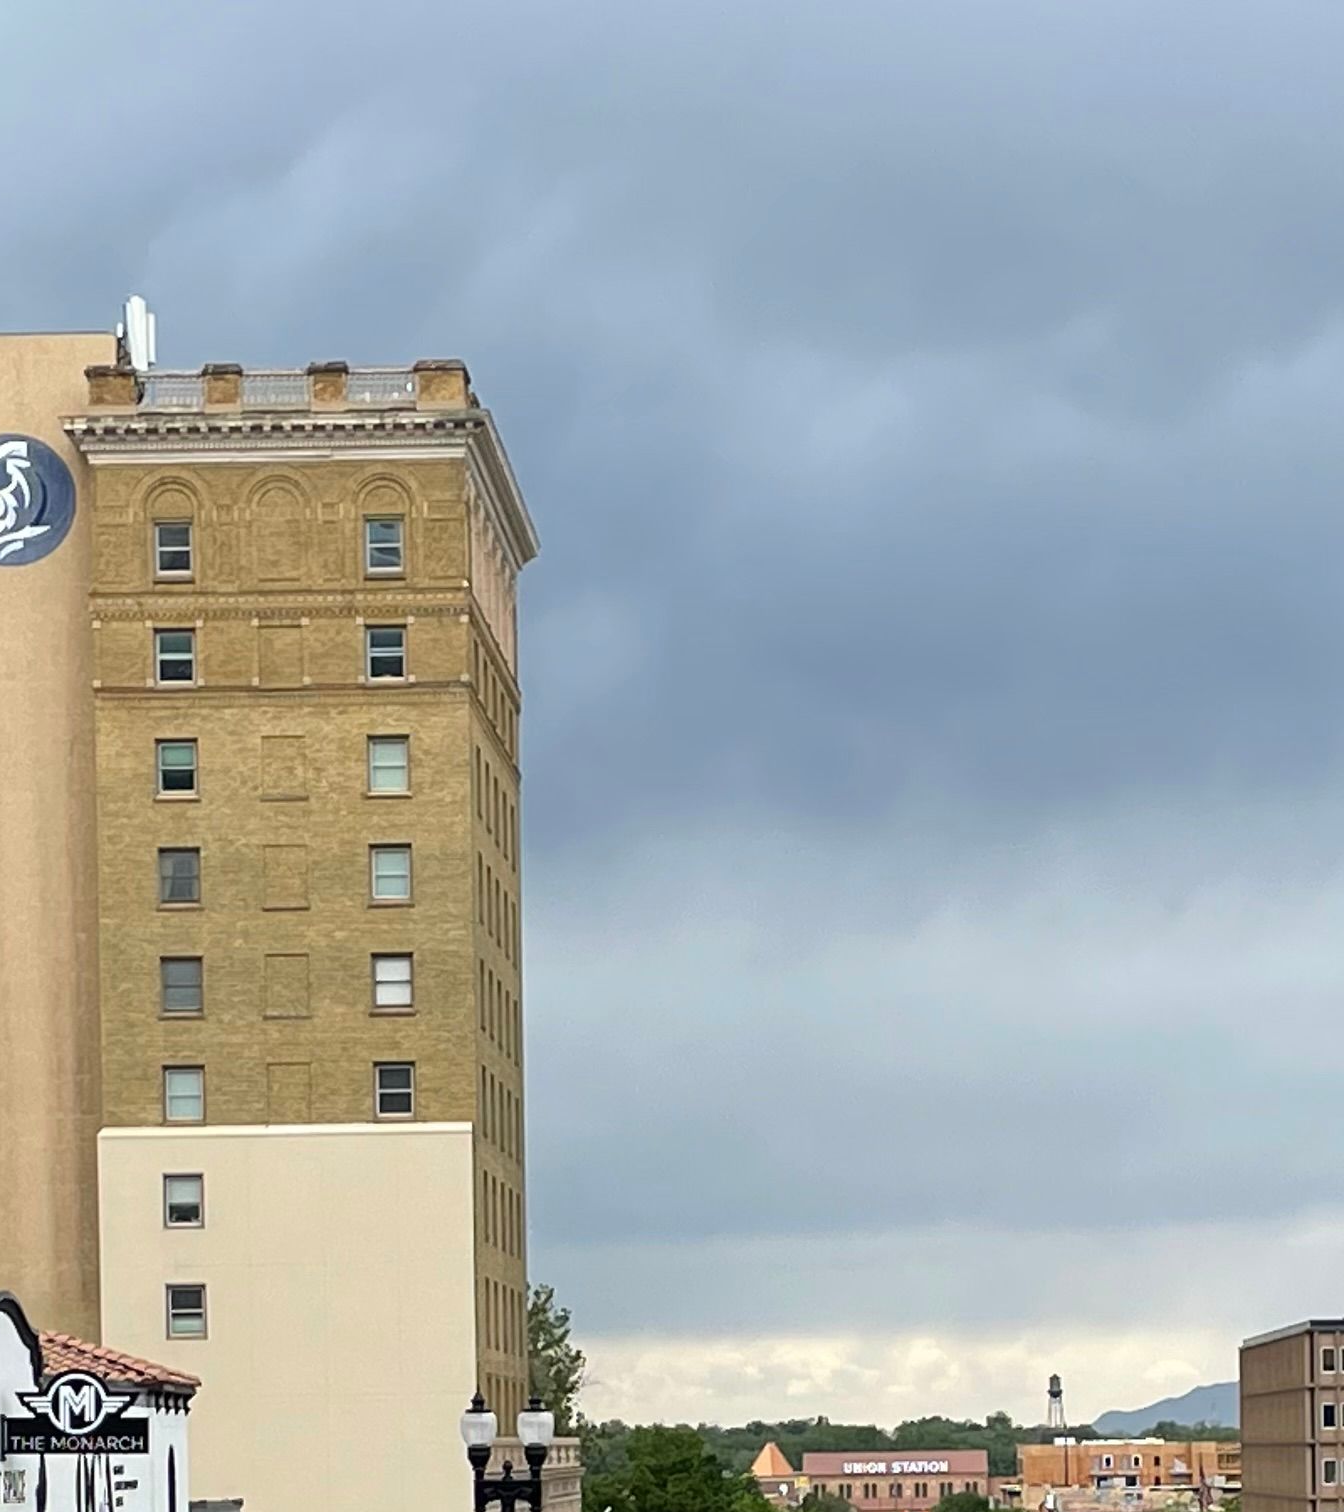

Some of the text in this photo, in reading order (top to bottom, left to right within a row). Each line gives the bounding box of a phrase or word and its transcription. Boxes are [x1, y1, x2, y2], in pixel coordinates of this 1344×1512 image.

[58, 1385, 96, 1431] M
[10, 1434, 144, 1451] THE MONARCH
[843, 1461, 949, 1474] UNION STATION
